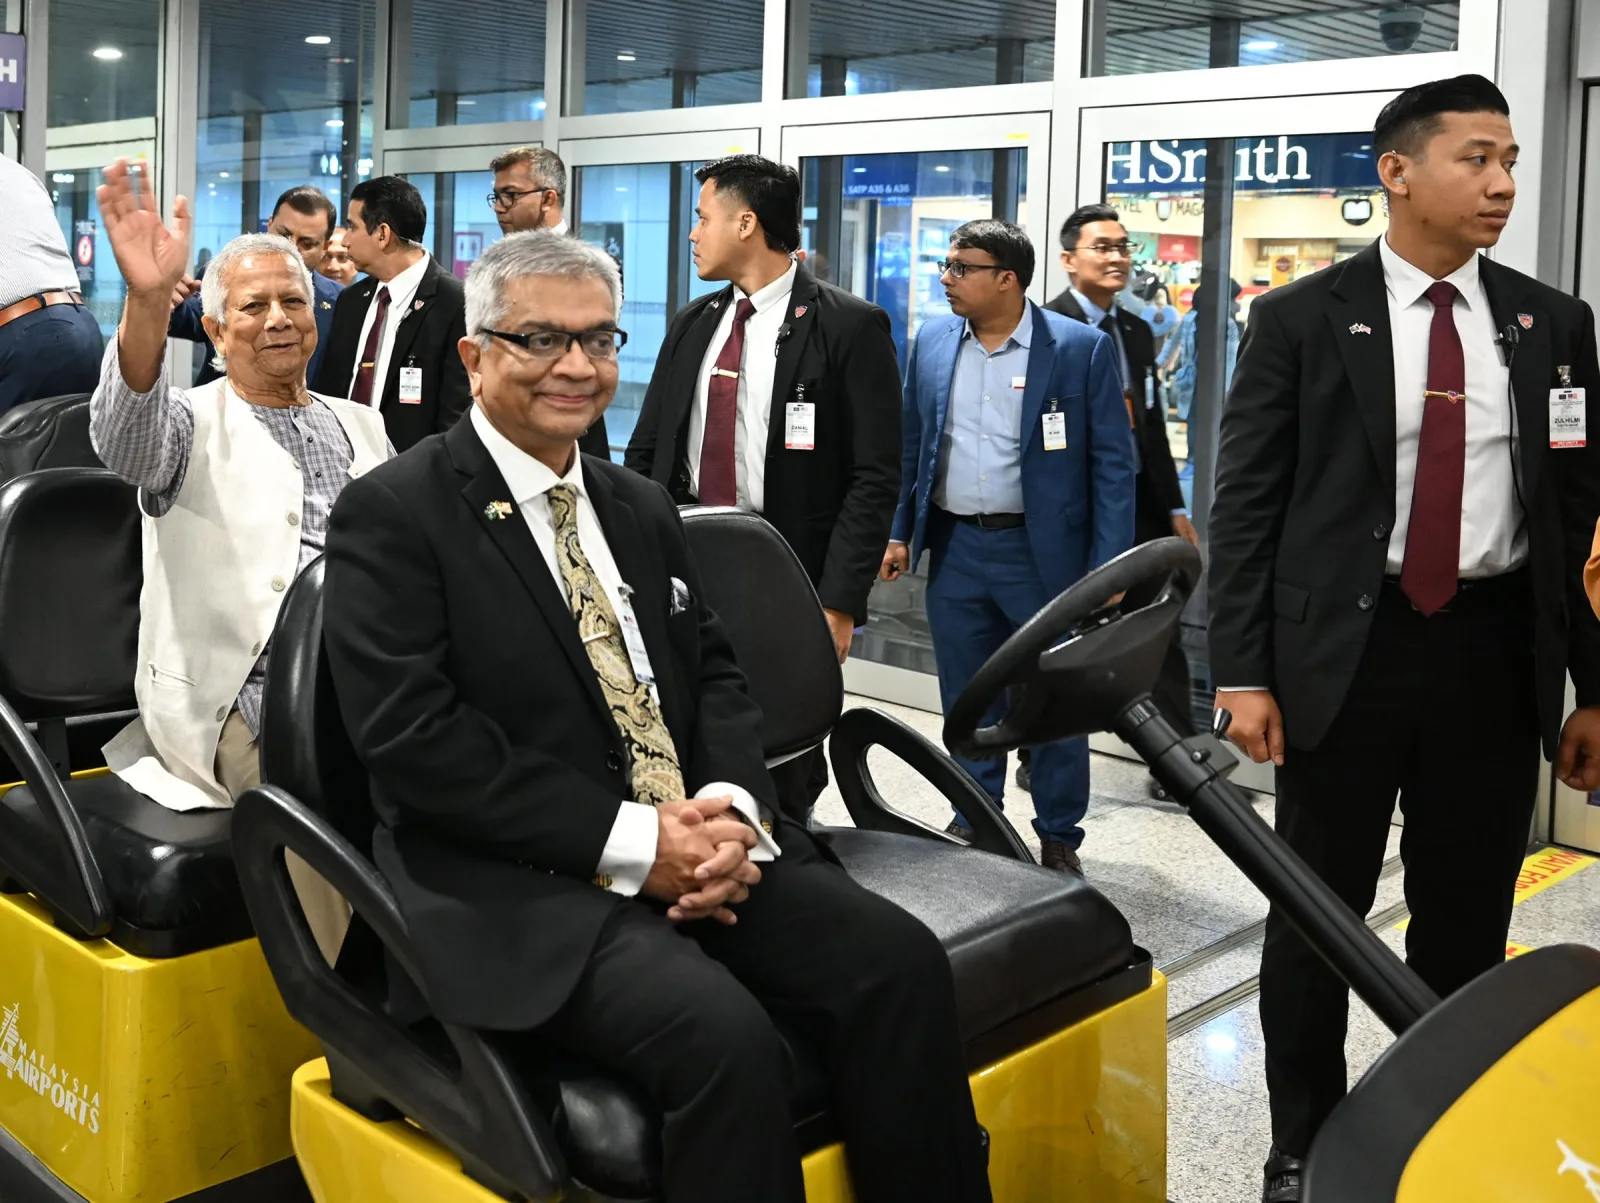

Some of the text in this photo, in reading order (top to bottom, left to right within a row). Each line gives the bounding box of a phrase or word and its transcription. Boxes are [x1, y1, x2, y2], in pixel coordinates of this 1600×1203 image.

[0, 57, 17, 83] H
[13, 1054, 100, 1134] AIRPORTS
[18, 1038, 100, 1108] MALAYSIA
